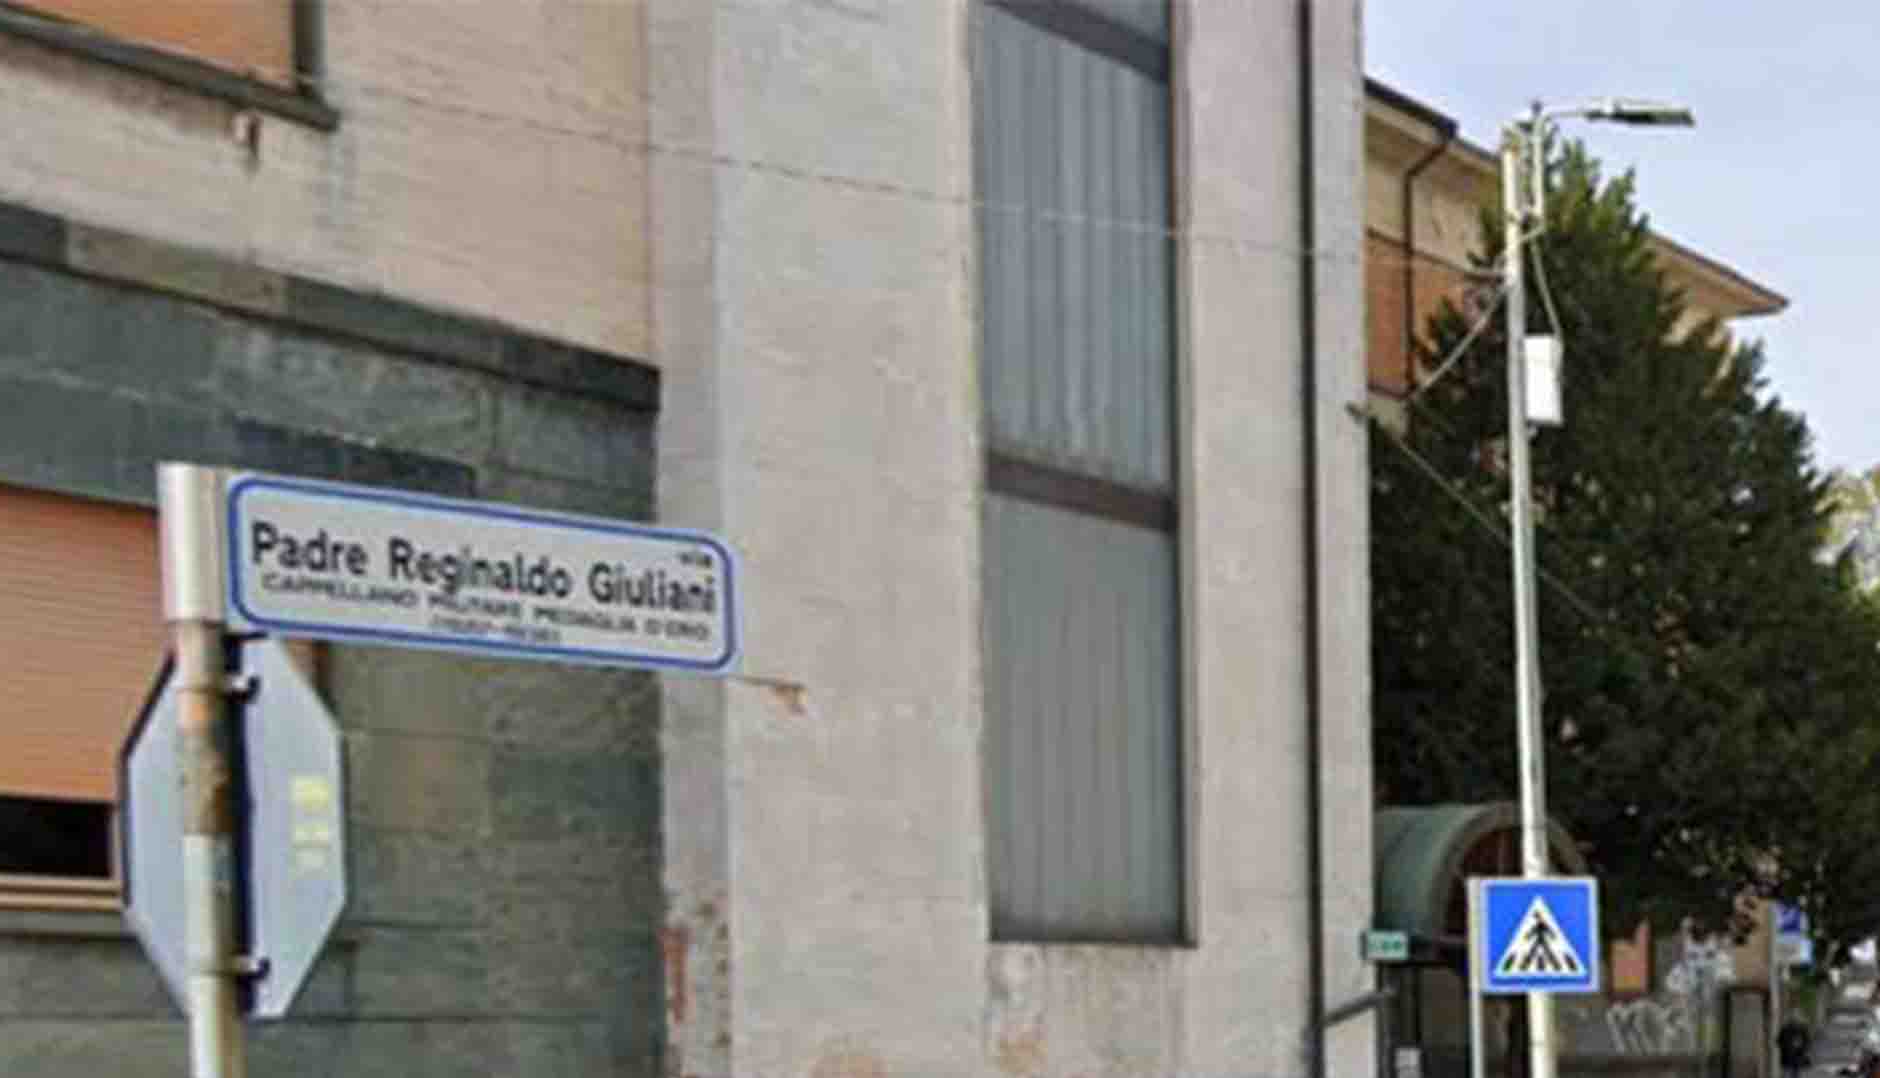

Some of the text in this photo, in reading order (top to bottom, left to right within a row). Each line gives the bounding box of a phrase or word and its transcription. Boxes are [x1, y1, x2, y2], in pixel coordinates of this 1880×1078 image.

[252, 521, 716, 616] Padre Reginaldo Giuliani
[263, 573, 418, 608] CAPPELLANO
